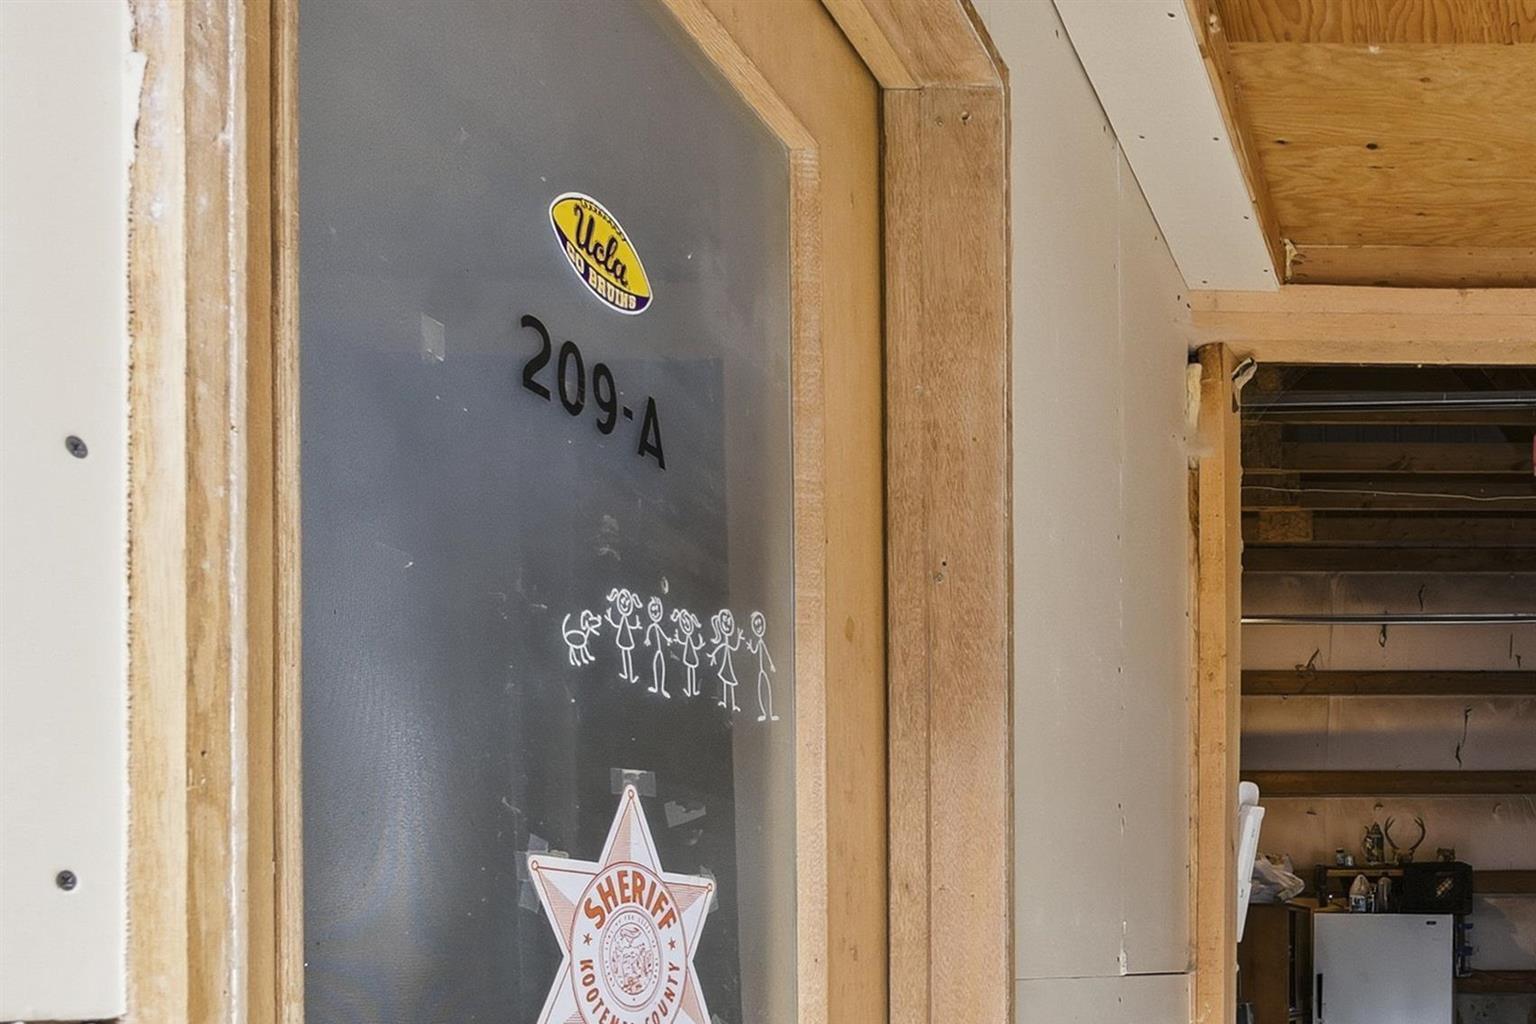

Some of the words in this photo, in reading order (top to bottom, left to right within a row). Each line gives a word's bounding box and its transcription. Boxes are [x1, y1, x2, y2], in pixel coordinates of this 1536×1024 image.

[566, 240, 585, 275] GO
[588, 269, 637, 310] BRUINS
[572, 203, 628, 286] Ucla
[520, 313, 666, 471] 209-A
[583, 870, 677, 931] SHERIFF
